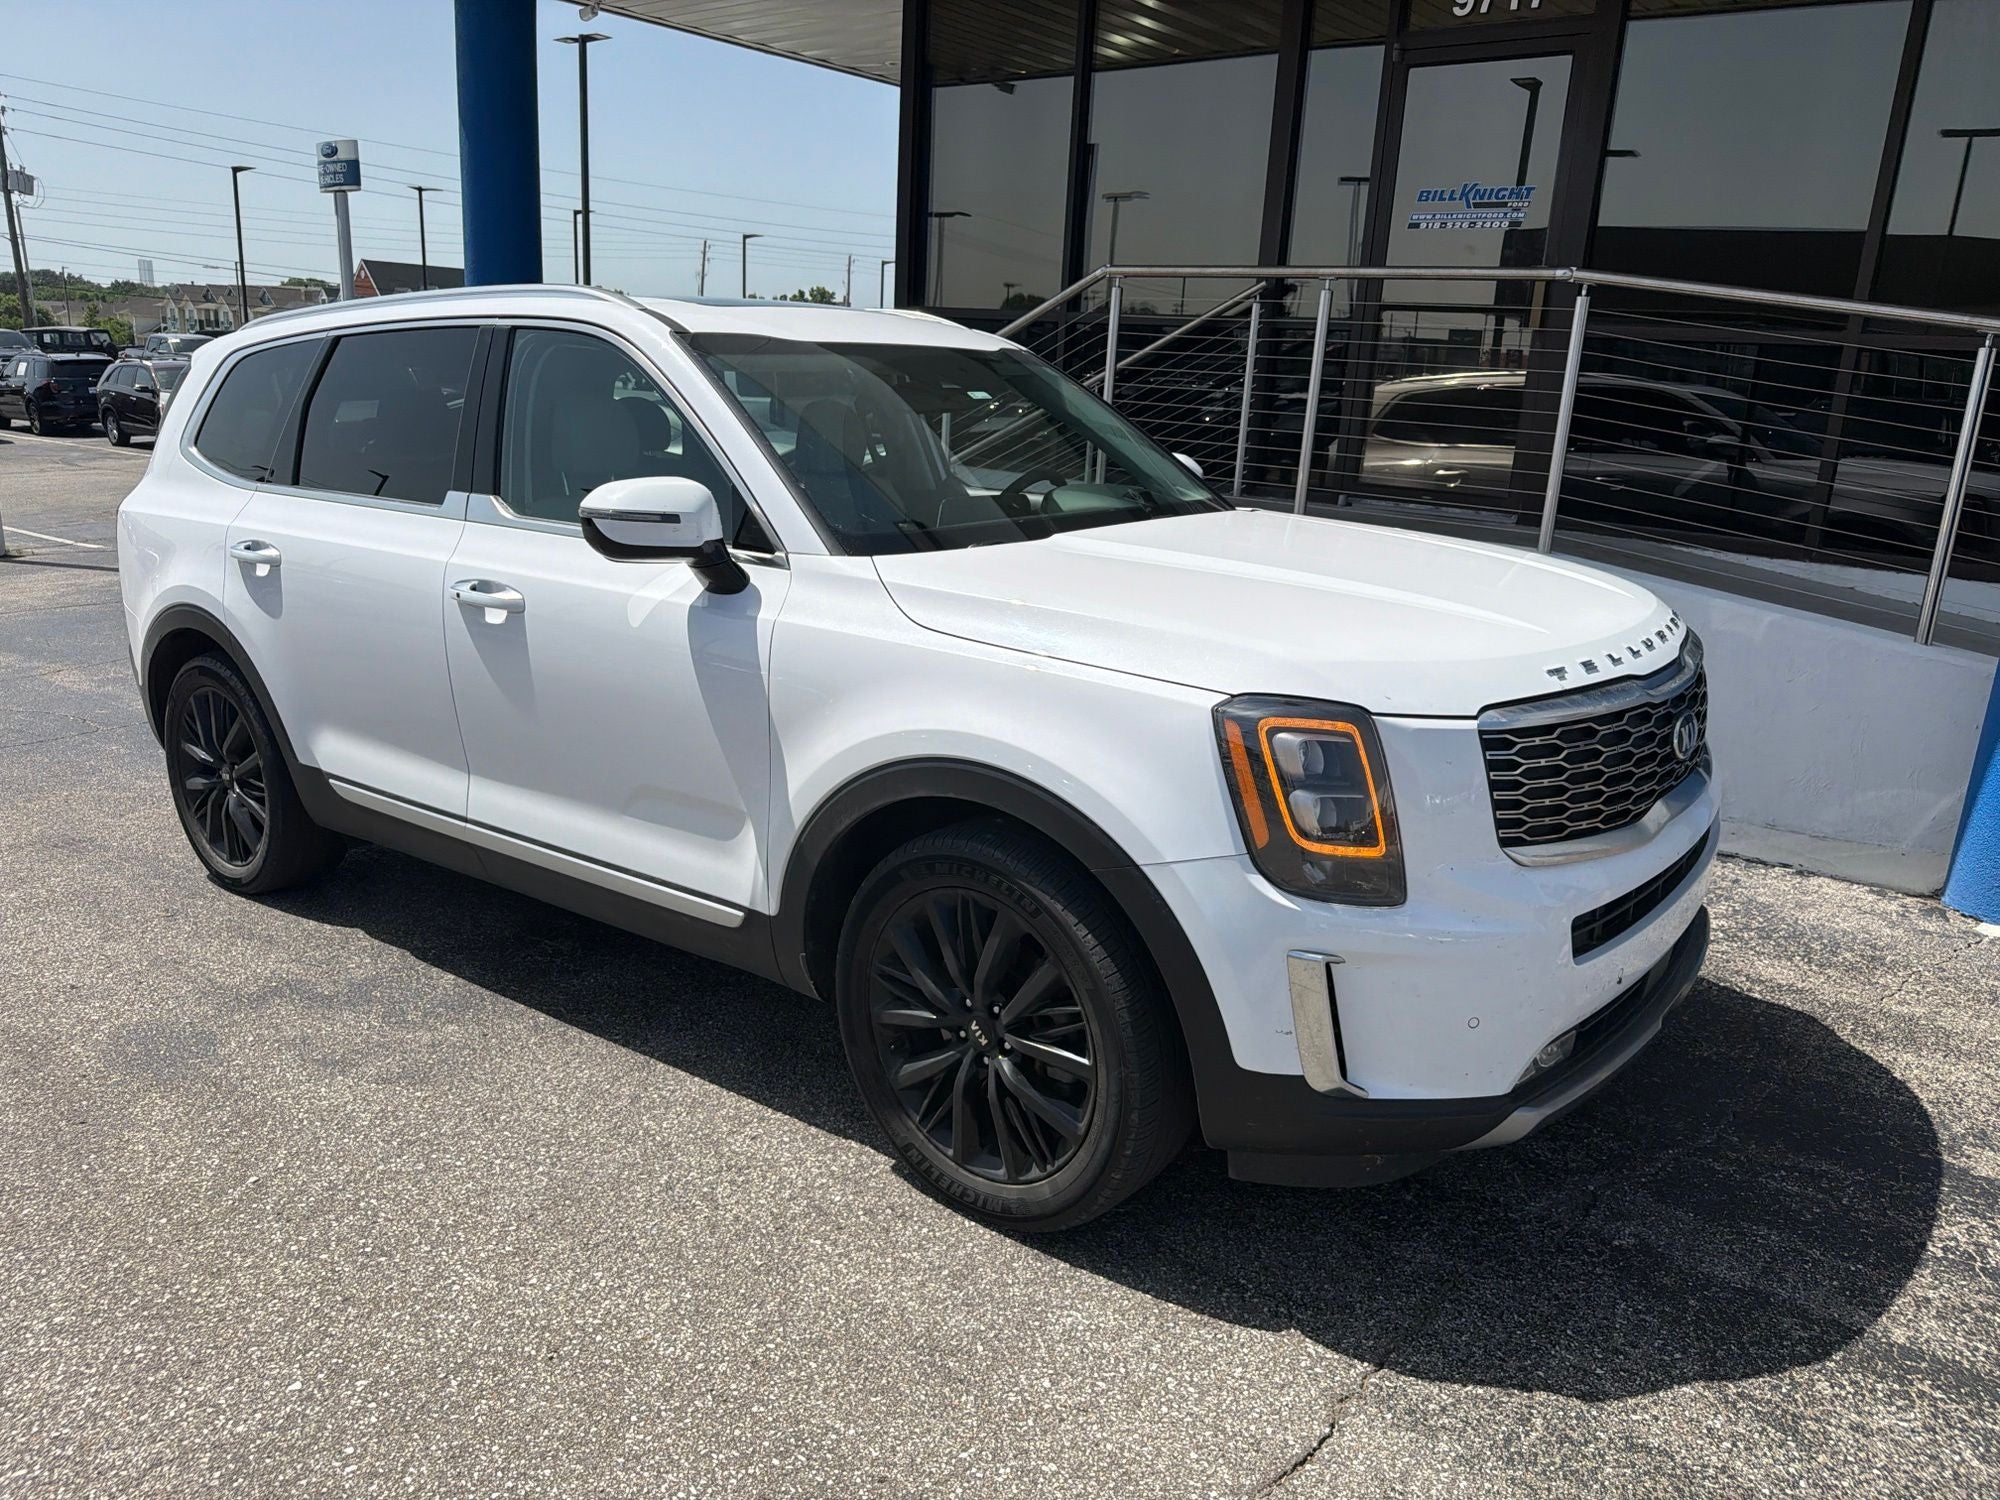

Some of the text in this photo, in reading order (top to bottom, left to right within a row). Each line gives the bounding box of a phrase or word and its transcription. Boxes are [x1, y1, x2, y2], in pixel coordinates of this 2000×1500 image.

[1411, 212, 1525, 221] WWW.BILLKNIGHTFORD.COM
[1419, 221, 1510, 230] 918-526-2400
[934, 862, 1040, 916] MICHELIN
[970, 1019, 989, 1046] KIA
[905, 1146, 1004, 1213] MICHELIN
